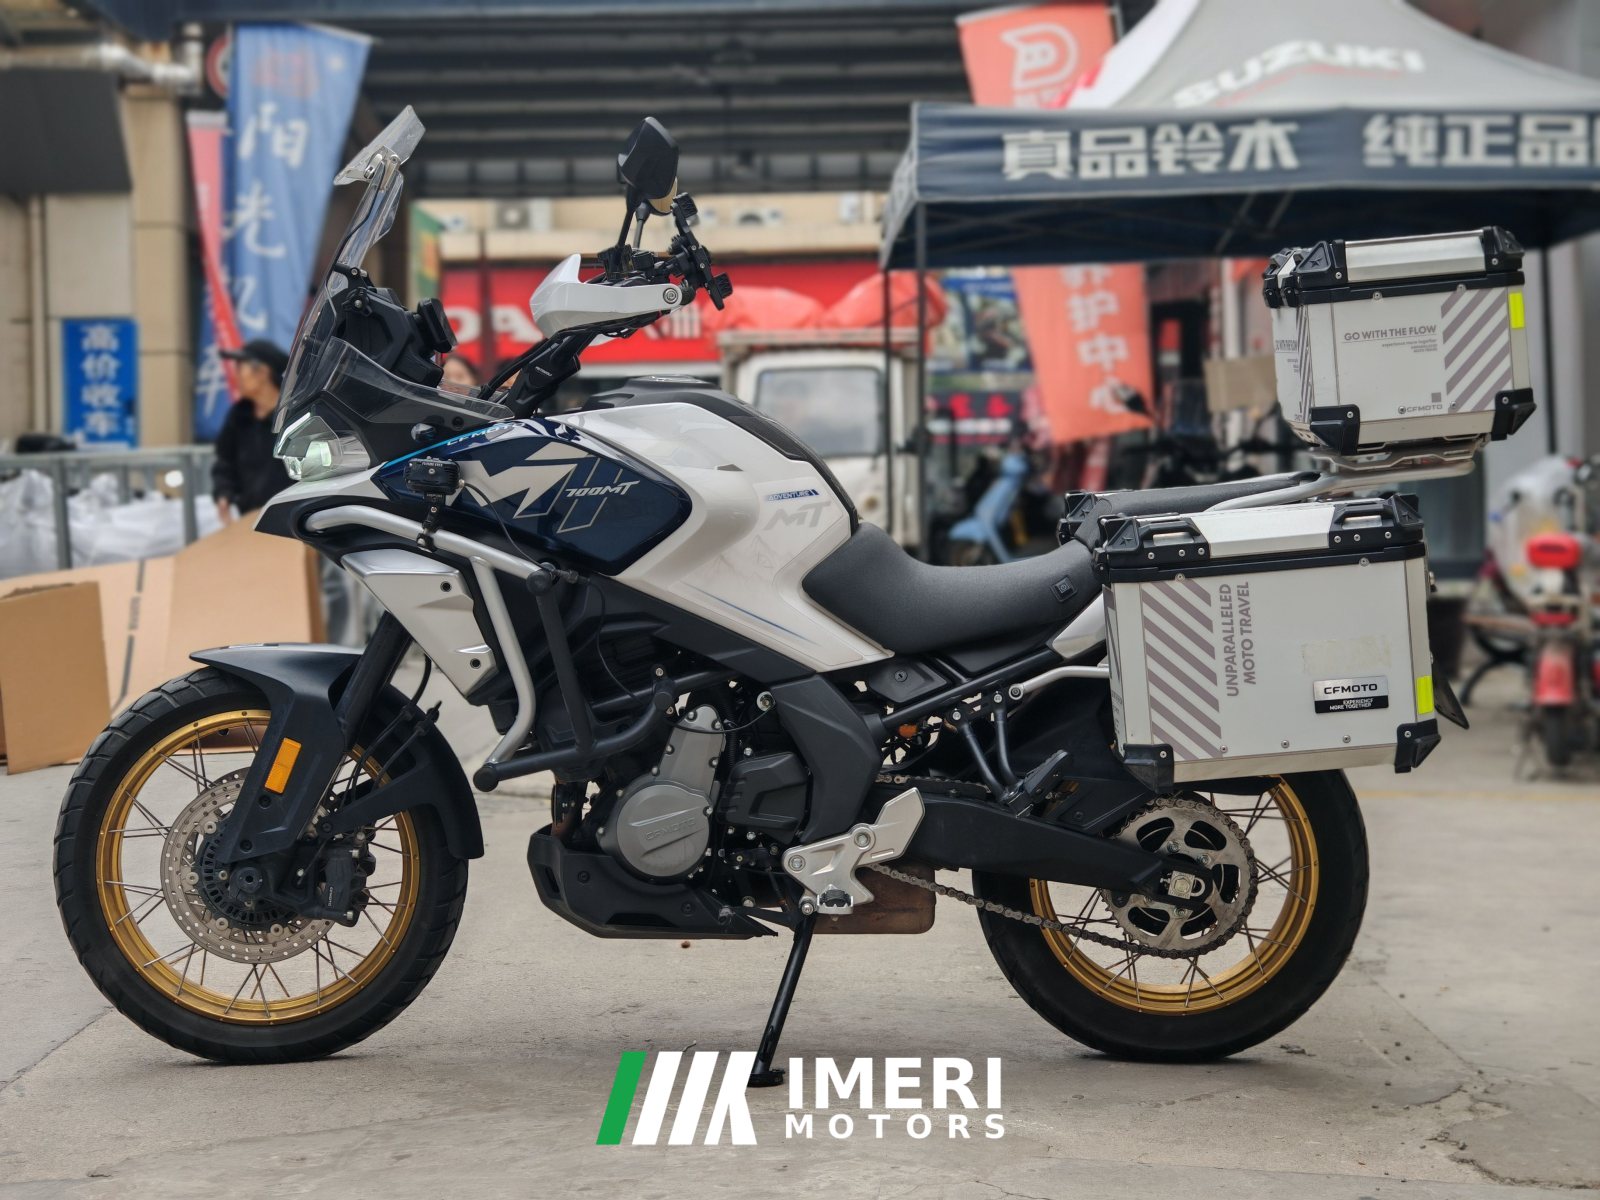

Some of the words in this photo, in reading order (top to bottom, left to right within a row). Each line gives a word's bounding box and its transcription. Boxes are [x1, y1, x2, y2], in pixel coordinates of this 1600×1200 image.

[1173, 40, 1425, 108] SUZUKI
[1002, 119, 1299, 180] 真品铃木
[1363, 113, 1600, 168] 纯正品
[1344, 332, 1360, 341] GO
[1362, 329, 1387, 339] WITH
[1389, 327, 1407, 337] THE
[1408, 325, 1437, 335] FLOW
[1407, 404, 1443, 413] CFMOTO
[565, 480, 640, 497] 700MT
[768, 489, 810, 501] ADVENTURE
[763, 500, 832, 531] MT
[1237, 581, 1252, 636] TRAVEL
[1219, 583, 1239, 697] UNPARALLELED
[1240, 638, 1256, 685] MOTO
[1324, 683, 1378, 695] CFMOTO
